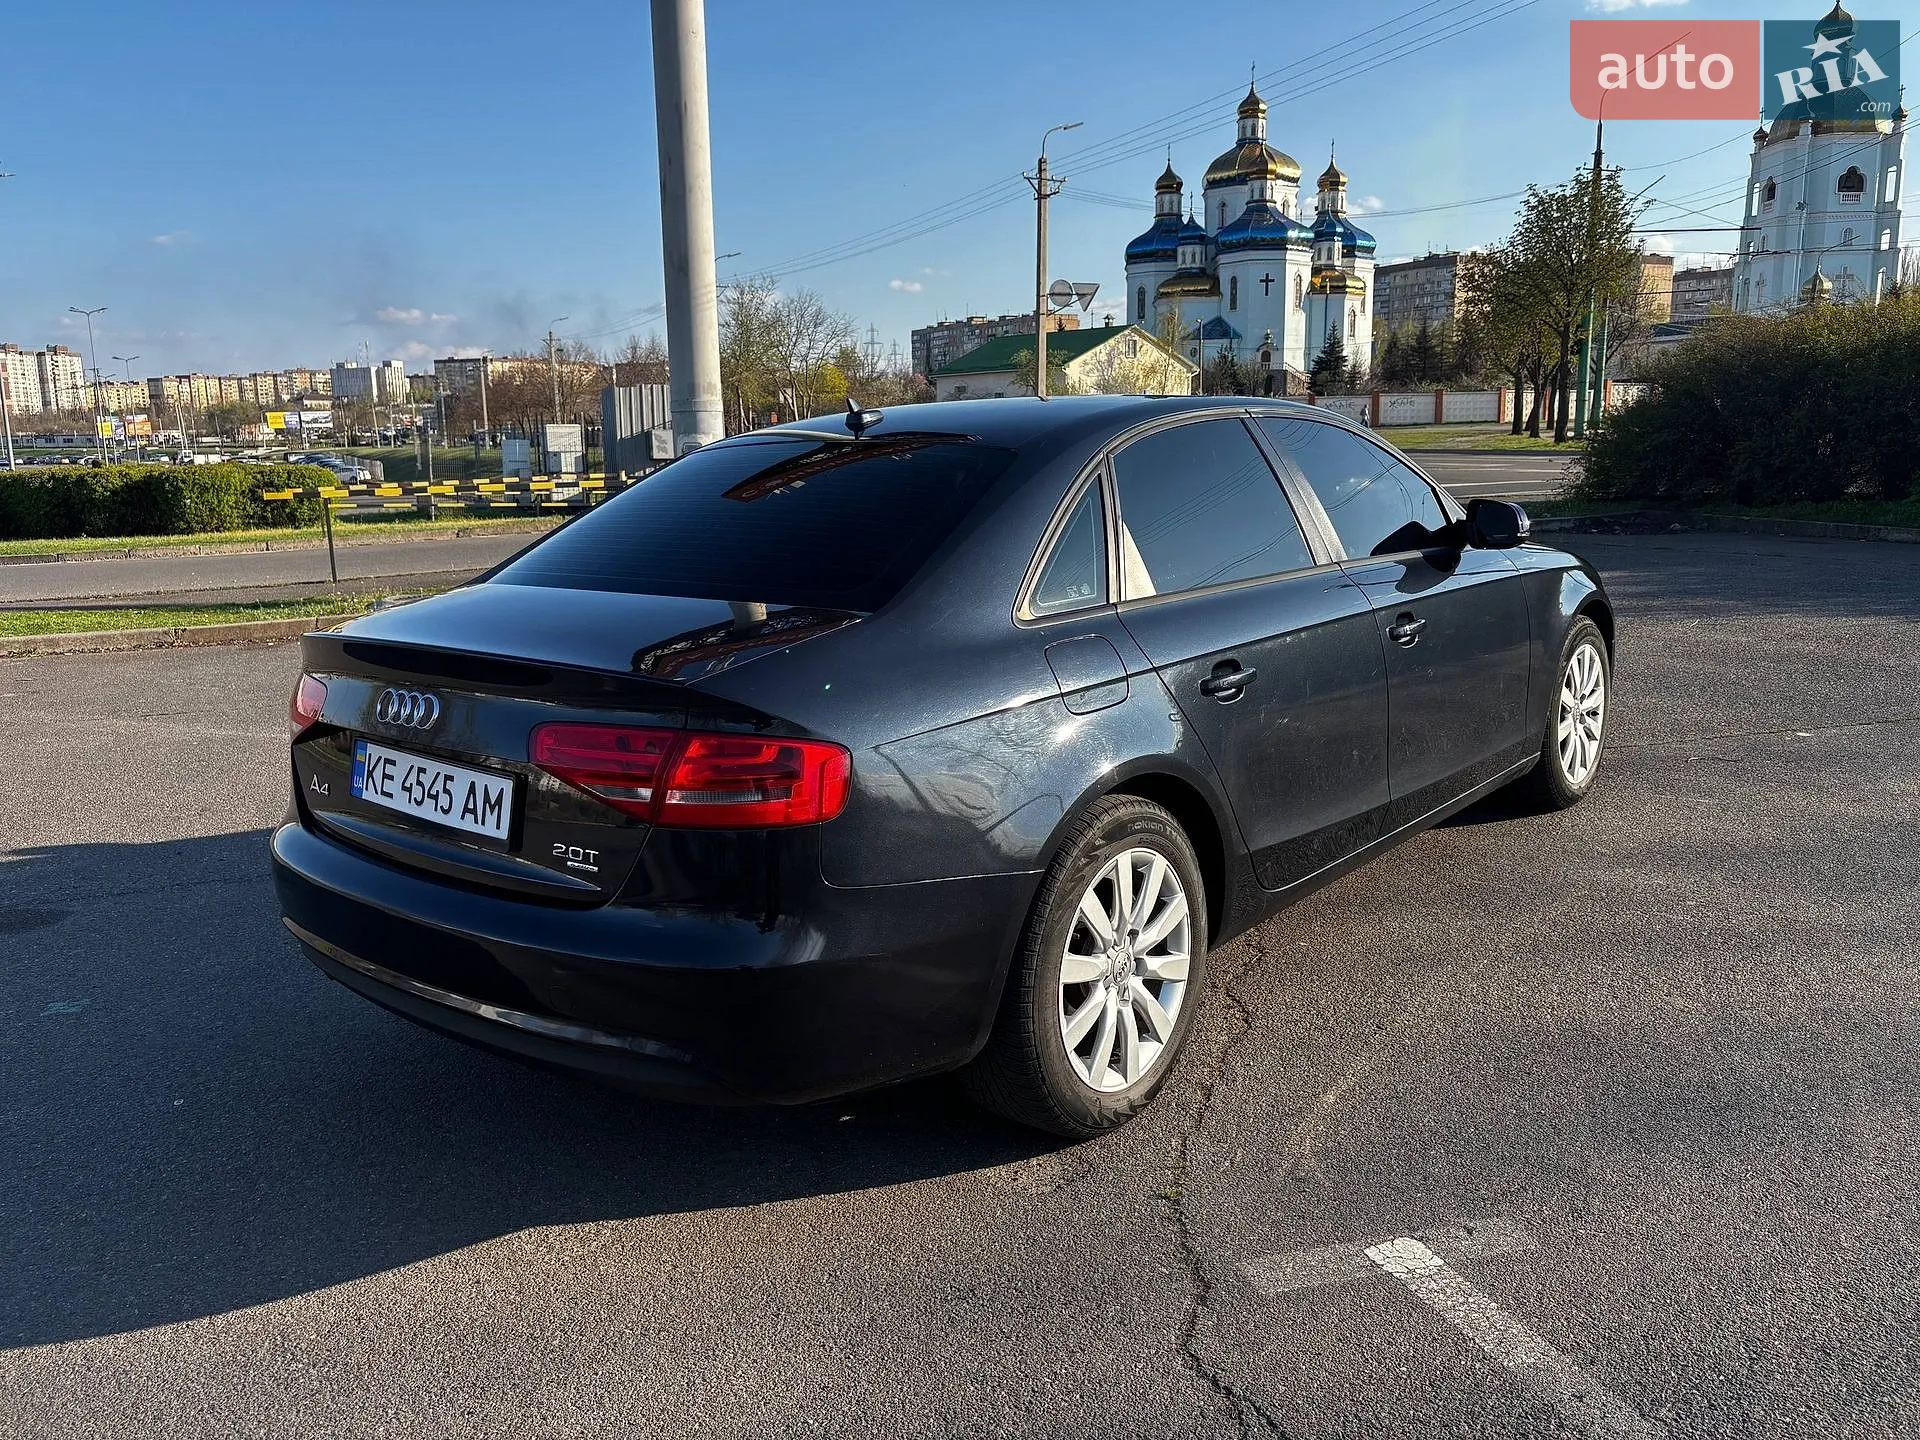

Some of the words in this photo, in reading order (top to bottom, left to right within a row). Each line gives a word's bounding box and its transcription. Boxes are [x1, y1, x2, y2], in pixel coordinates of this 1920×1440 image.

[310, 774, 330, 797] A4
[353, 775, 363, 789] UA
[365, 753, 397, 799] KE
[401, 764, 455, 815] 4545
[460, 780, 505, 830] AM
[552, 843, 599, 863] 2.0T
